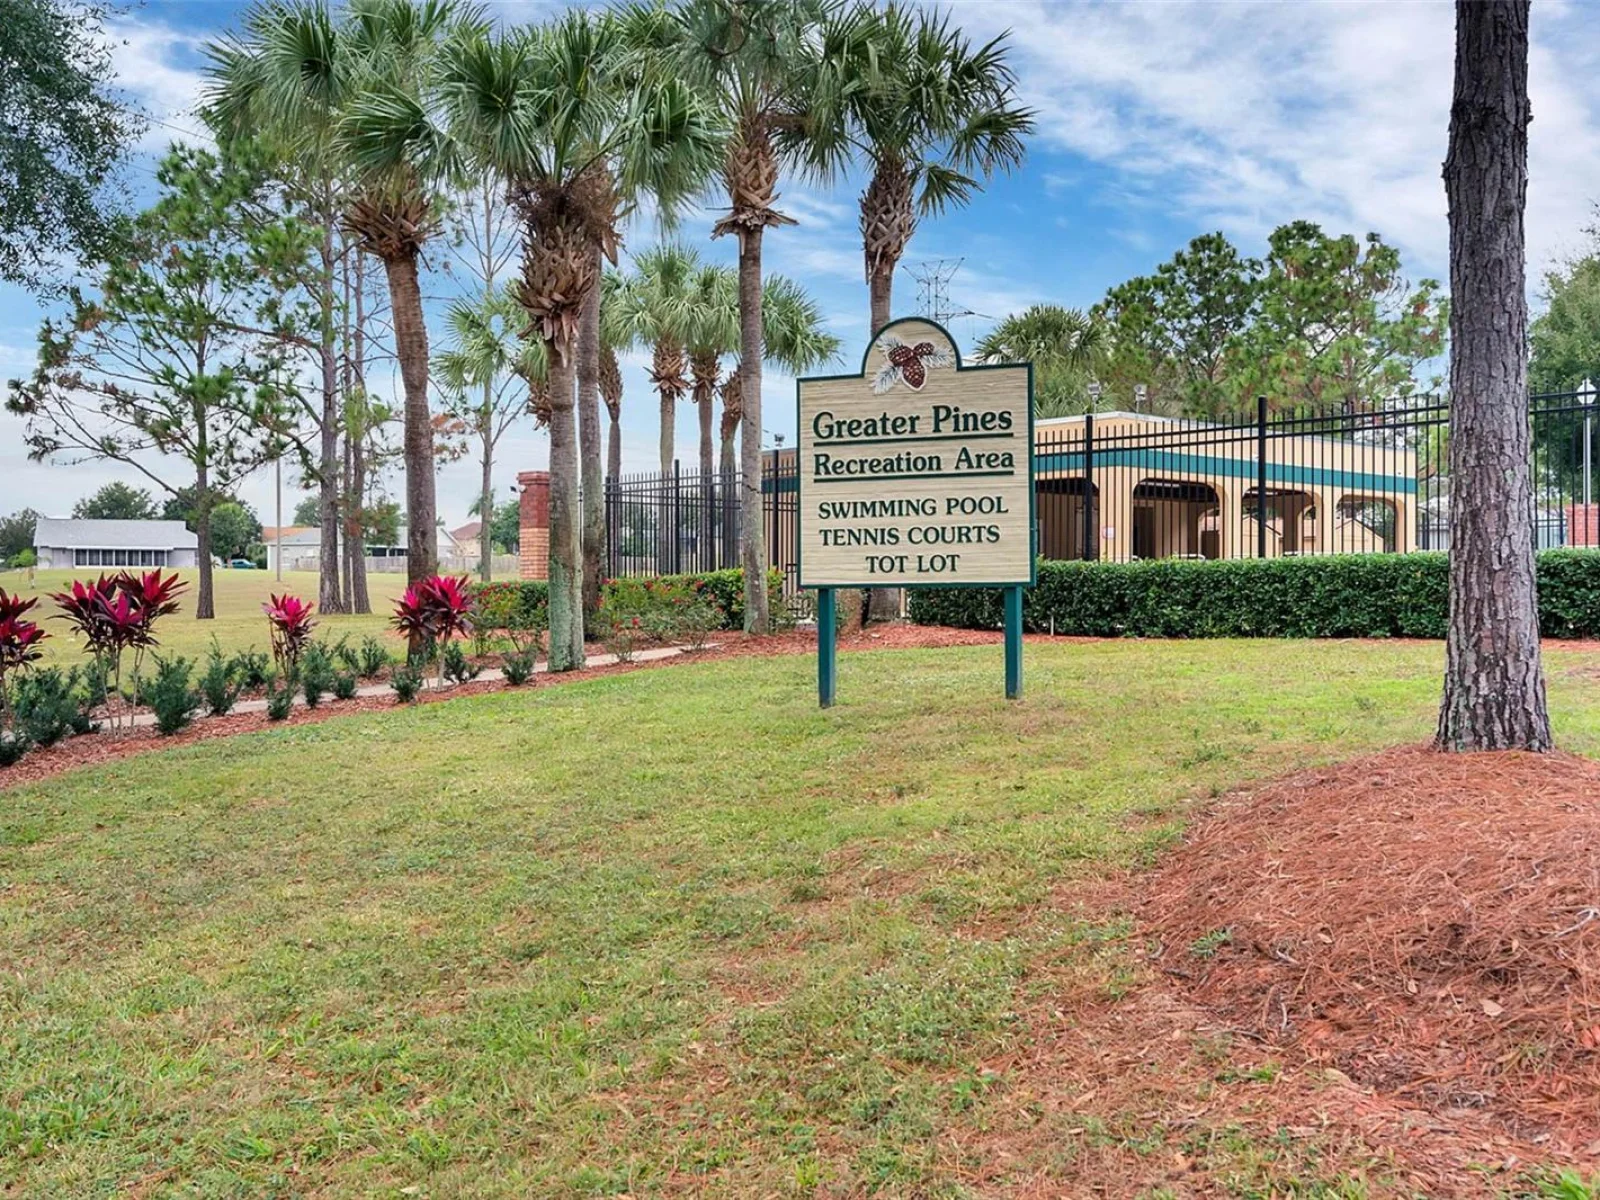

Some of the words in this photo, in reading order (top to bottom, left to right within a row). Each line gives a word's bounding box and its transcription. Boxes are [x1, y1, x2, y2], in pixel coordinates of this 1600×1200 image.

[813, 411, 920, 439] Greater
[932, 405, 1012, 433] Pines
[814, 451, 942, 476] Recreation
[955, 447, 1014, 470] Area
[818, 498, 937, 520] SWIMMING
[946, 496, 1008, 515] POOL
[819, 528, 899, 546] TENNIS
[907, 525, 1000, 544] COURTS
[865, 555, 908, 573] TOT
[917, 554, 960, 572] LOT
